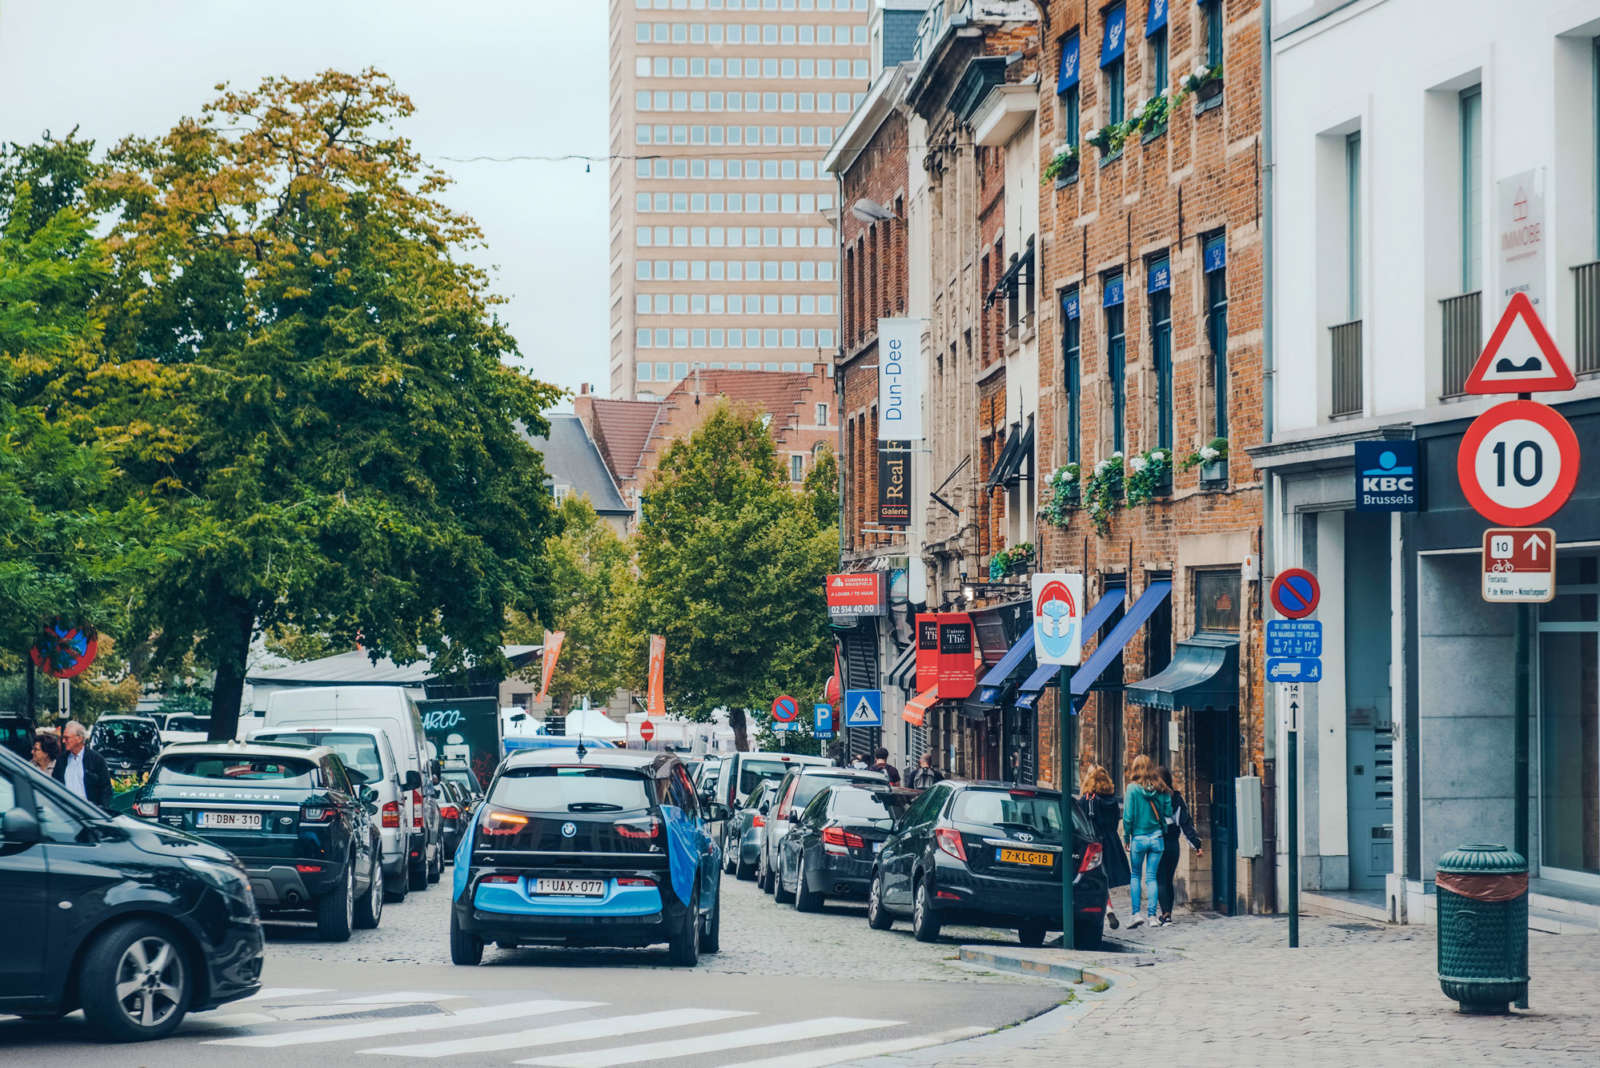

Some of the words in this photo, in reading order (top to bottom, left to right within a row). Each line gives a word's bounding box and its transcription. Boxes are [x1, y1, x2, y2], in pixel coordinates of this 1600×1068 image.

[885, 339, 902, 421] Dun-Dee
[1492, 440, 1543, 487] 10
[886, 459, 904, 499] Real
[1362, 477, 1414, 492] KBC
[1363, 494, 1414, 505] Brussels
[881, 507, 908, 516] Galerie
[1496, 542, 1509, 552] 10
[853, 605, 863, 613] 40
[946, 633, 966, 644] Thé
[1282, 641, 1288, 652] 7
[1304, 641, 1312, 652] 17
[817, 708, 829, 726] P
[205, 814, 260, 825] 1-DBN-310
[1006, 851, 1048, 864] 7-KLG-18
[538, 880, 602, 893] 1-UAX-077
